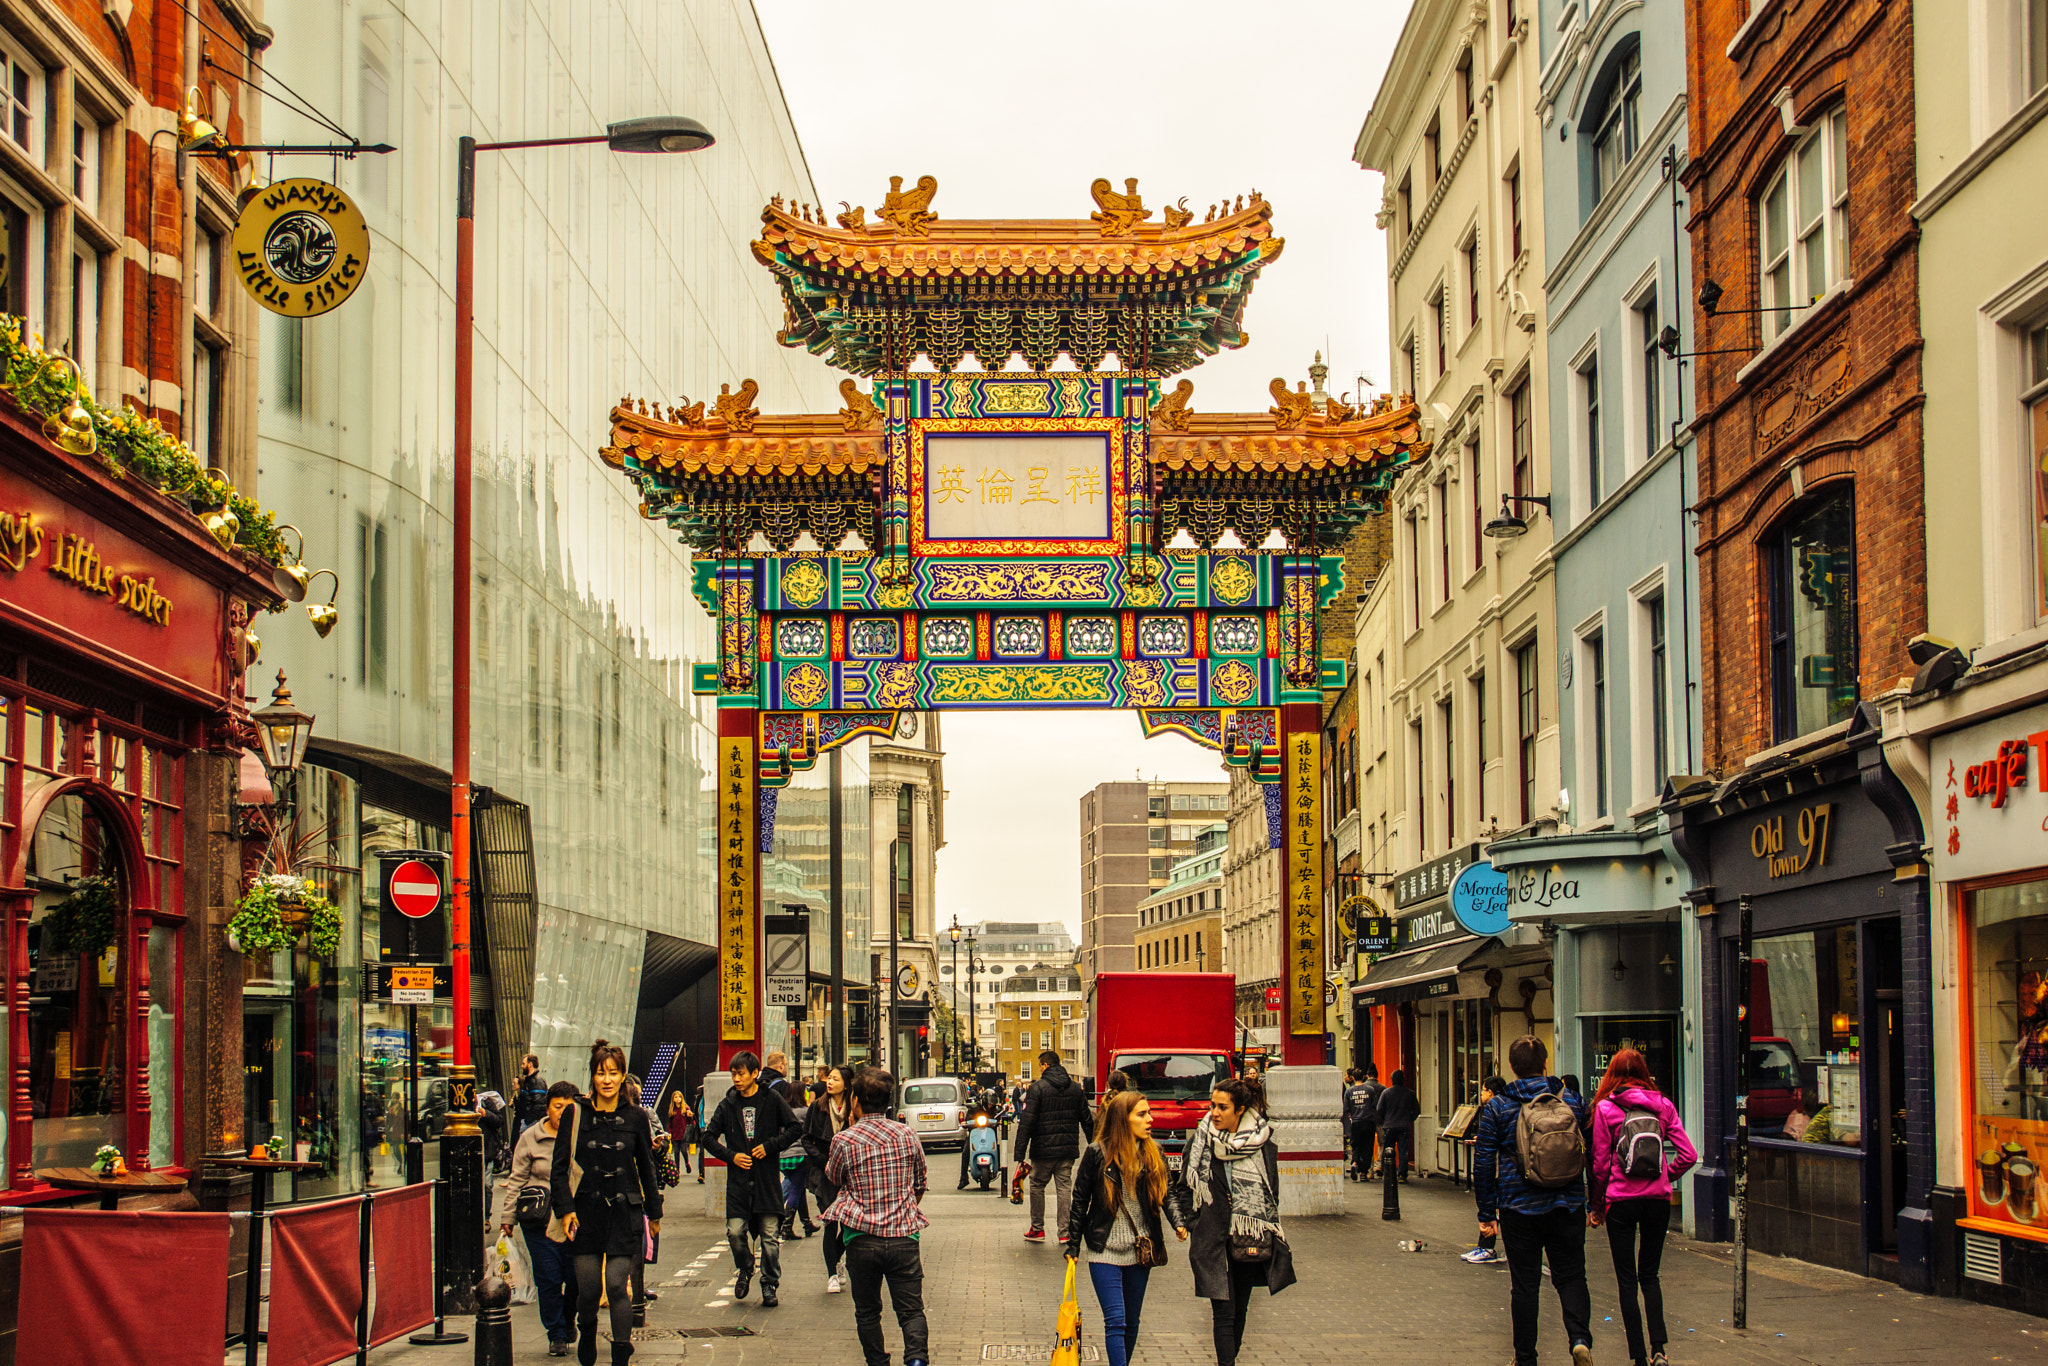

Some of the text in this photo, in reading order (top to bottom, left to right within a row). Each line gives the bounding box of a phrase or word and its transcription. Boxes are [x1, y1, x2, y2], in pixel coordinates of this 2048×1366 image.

[932, 463, 1104, 505] 英倫呈祥
[1964, 739, 2027, 809] café
[1751, 802, 1833, 871] Old 97
[1767, 853, 1799, 879] Town
[1459, 880, 1507, 897] Morde
[1519, 874, 1536, 902] &
[1534, 868, 1580, 908] Lea
[1471, 897, 1508, 915] & Lea
[1412, 911, 1443, 942] ORIENT
[771, 994, 801, 1003] ENDS
